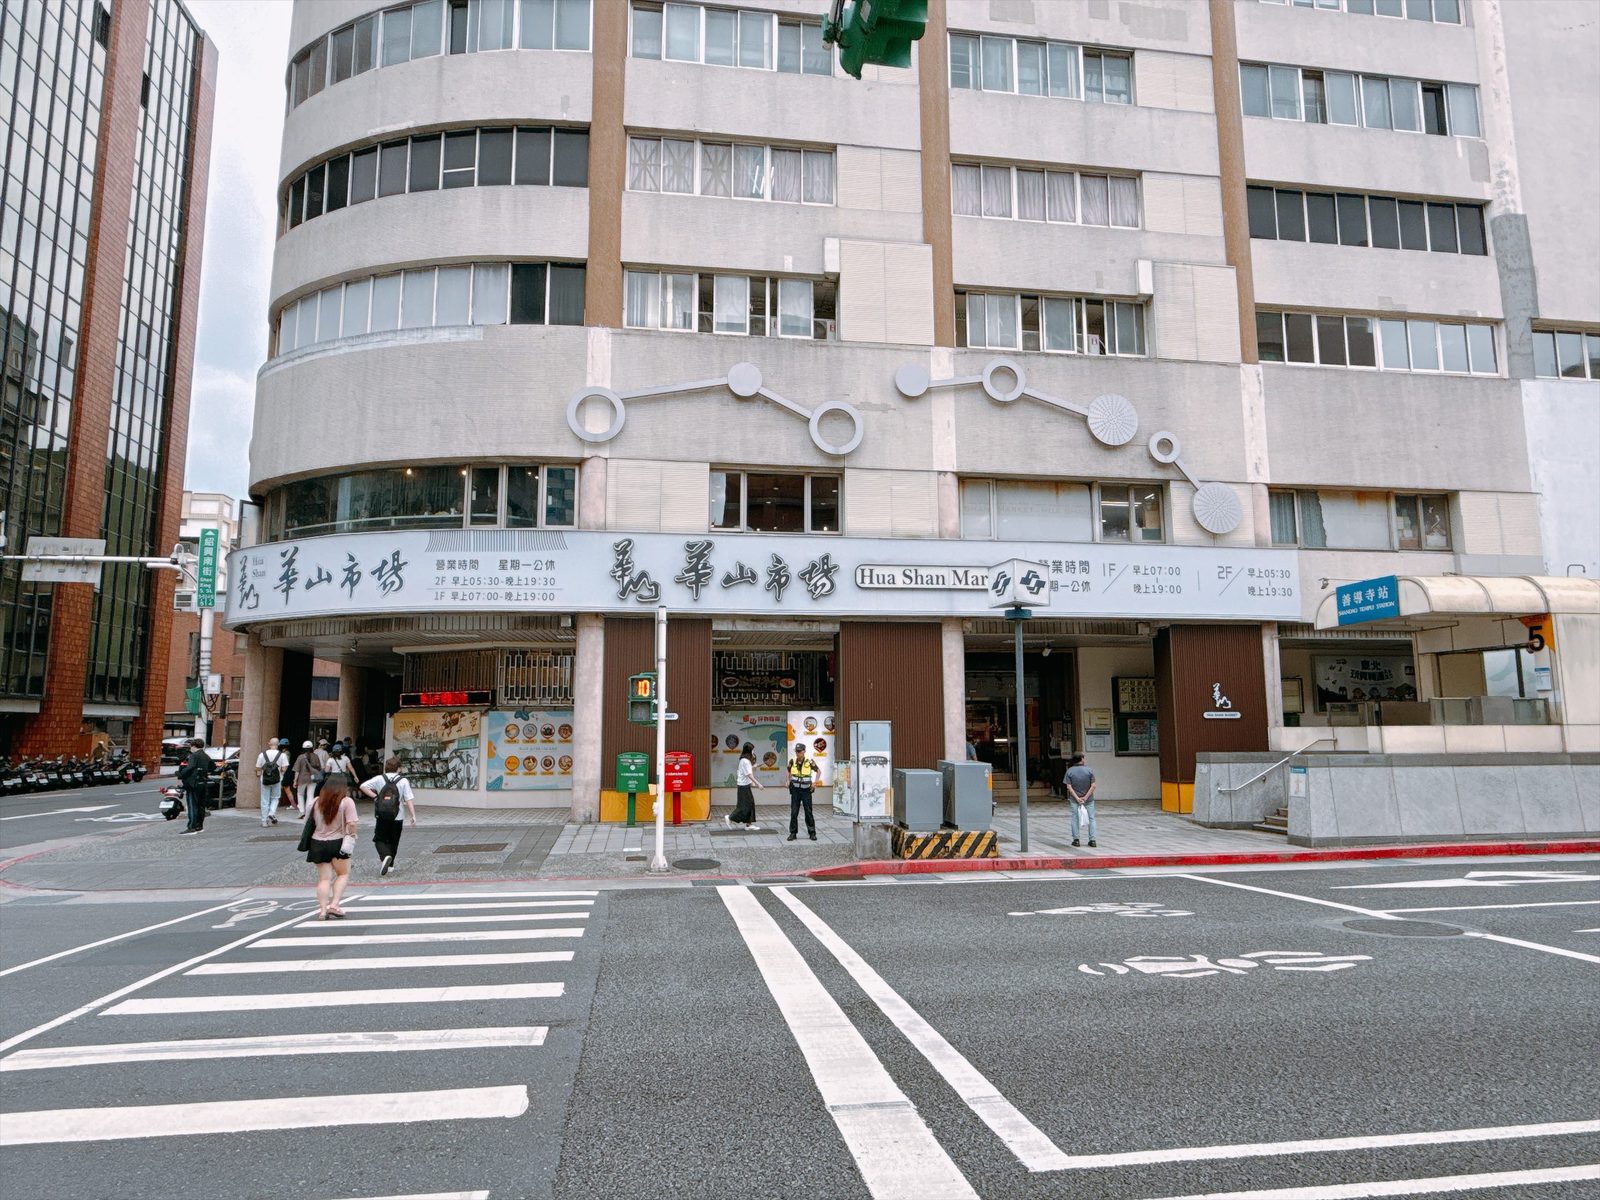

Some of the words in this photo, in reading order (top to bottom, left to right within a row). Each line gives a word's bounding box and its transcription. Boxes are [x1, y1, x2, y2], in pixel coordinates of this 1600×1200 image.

[203, 537, 215, 576] 紹興南街
[435, 560, 479, 570] 營業時間
[499, 559, 555, 570] 星期一公休
[675, 540, 840, 602] 華山市場
[1038, 560, 1090, 574] 業時間
[1102, 563, 1116, 577] 1F
[1133, 565, 1181, 576] 早上07:00
[252, 570, 266, 579] Shan
[273, 546, 408, 606] 華山市場
[860, 568, 896, 585] Hua
[902, 569, 946, 586] Shan
[951, 570, 988, 586] Mar
[1217, 566, 1233, 580] 2F
[1247, 567, 1291, 579] 早上05:30
[435, 576, 446, 586] 2F
[452, 576, 556, 587] 早上05:30-晚上19:30
[1050, 580, 1090, 592] 期一公休
[1133, 583, 1182, 594] 晚上19:00
[434, 591, 446, 601] 1F
[450, 591, 555, 602] 早上07:00-晚上19:00
[1247, 586, 1293, 597] 晚上19:30
[1342, 585, 1389, 607] 善導寺站
[1528, 625, 1545, 652] 5
[637, 679, 650, 697] 10
